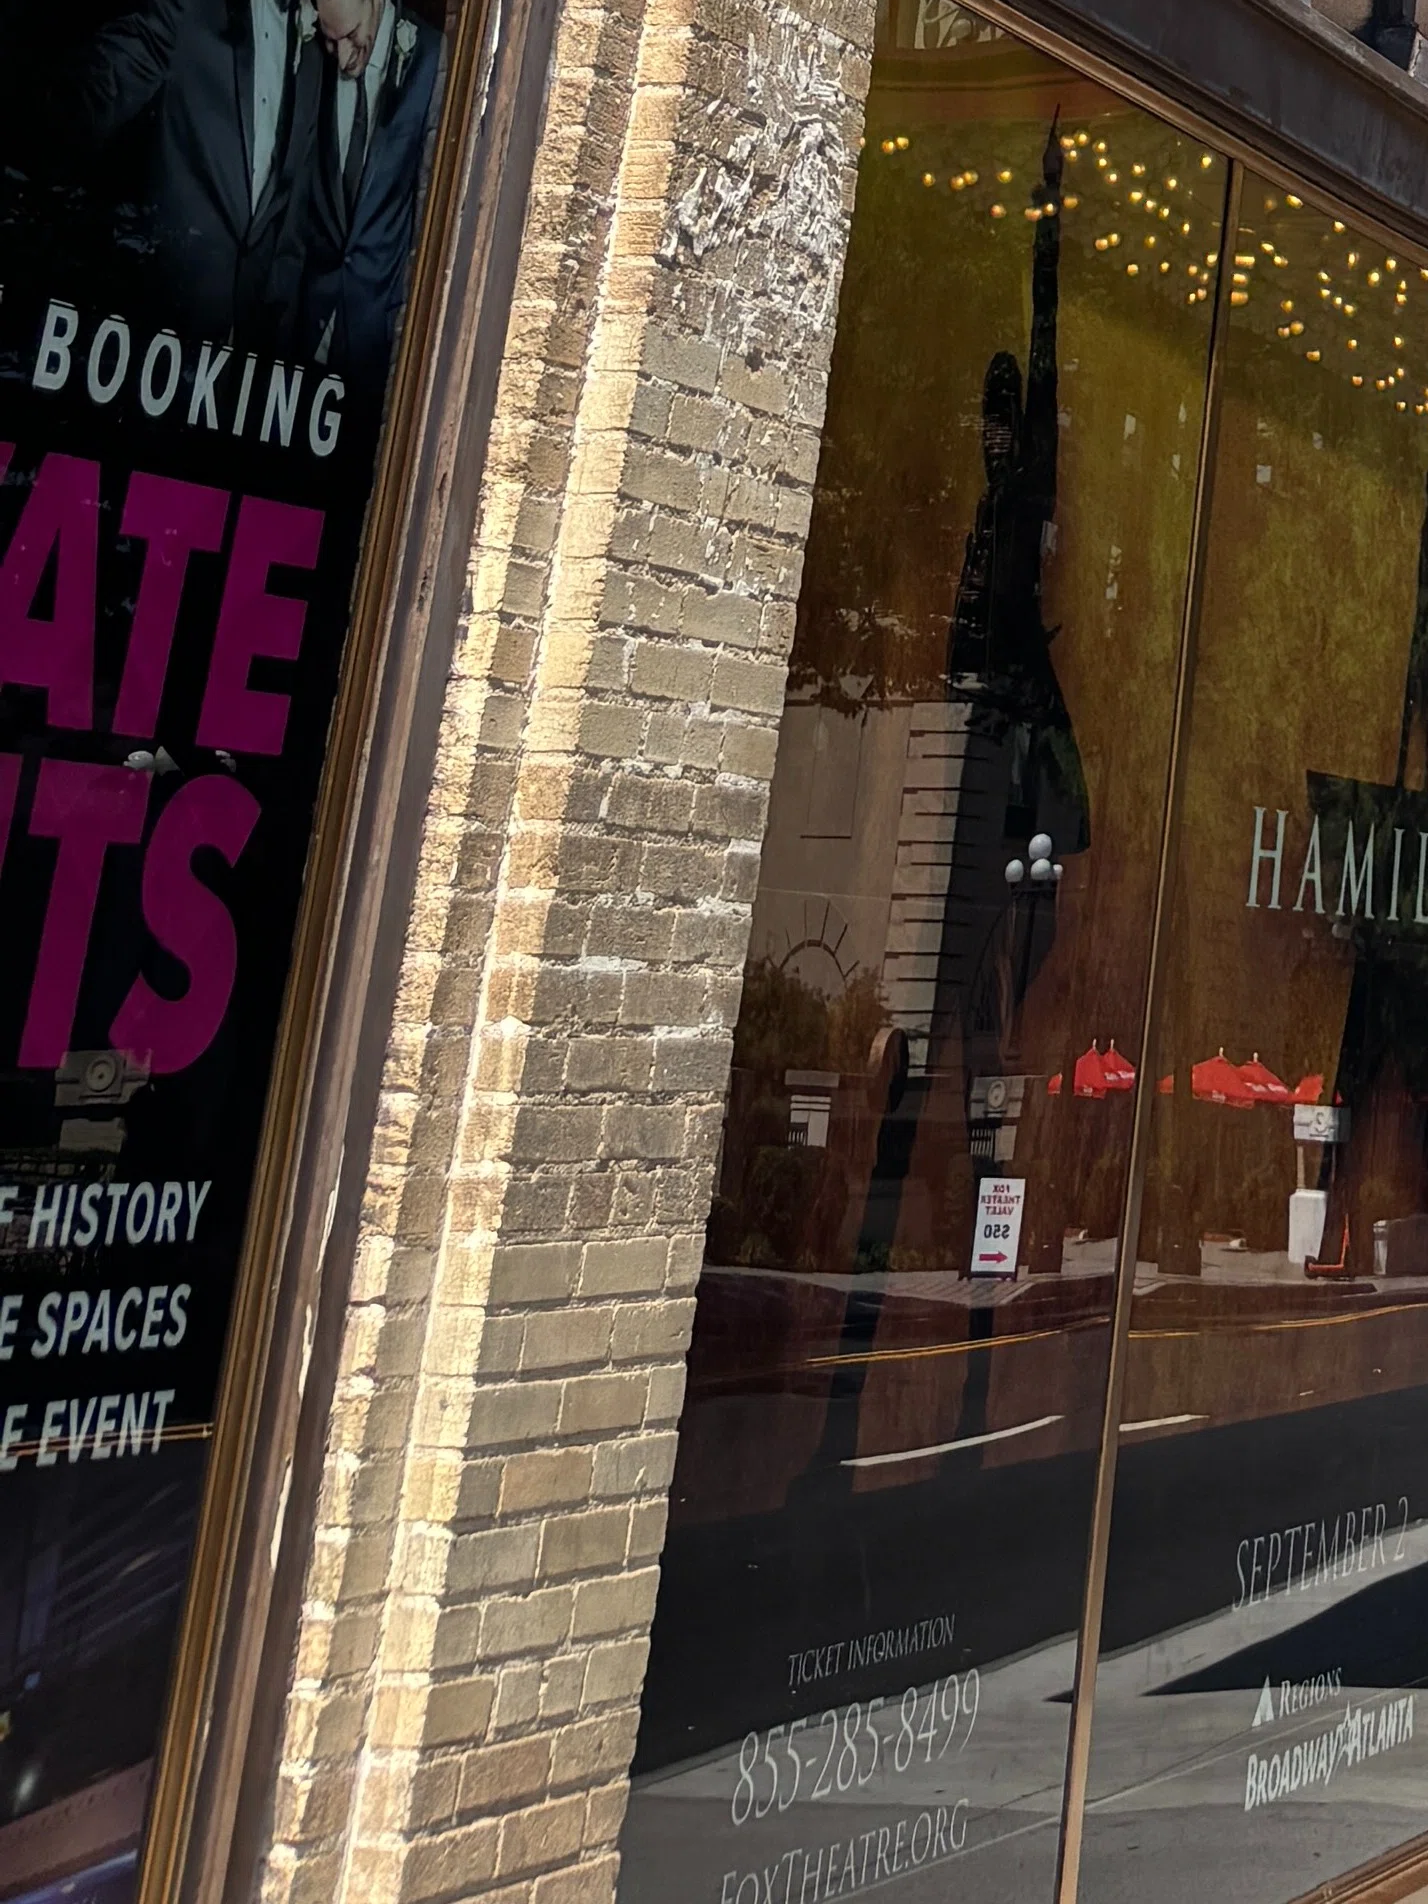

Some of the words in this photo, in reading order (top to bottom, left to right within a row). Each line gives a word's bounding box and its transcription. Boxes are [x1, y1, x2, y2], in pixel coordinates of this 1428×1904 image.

[32, 297, 345, 456] BOOKING
[0, 442, 326, 756] ATE
[0, 753, 262, 1074] TS
[27, 1180, 213, 1249] HISTORY
[31, 1284, 192, 1359] SPACES
[36, 1389, 175, 1467] EVENT
[1232, 1502, 1386, 1613] SEPTEMBER
[1393, 1496, 1409, 1561] 2
[789, 1642, 844, 1686] TICKET
[848, 1613, 955, 1671] INFORMATION
[1279, 1667, 1342, 1718] REGIONS
[731, 1668, 980, 1826] 855-285-8499
[1244, 1731, 1335, 1812] BROADWAY
